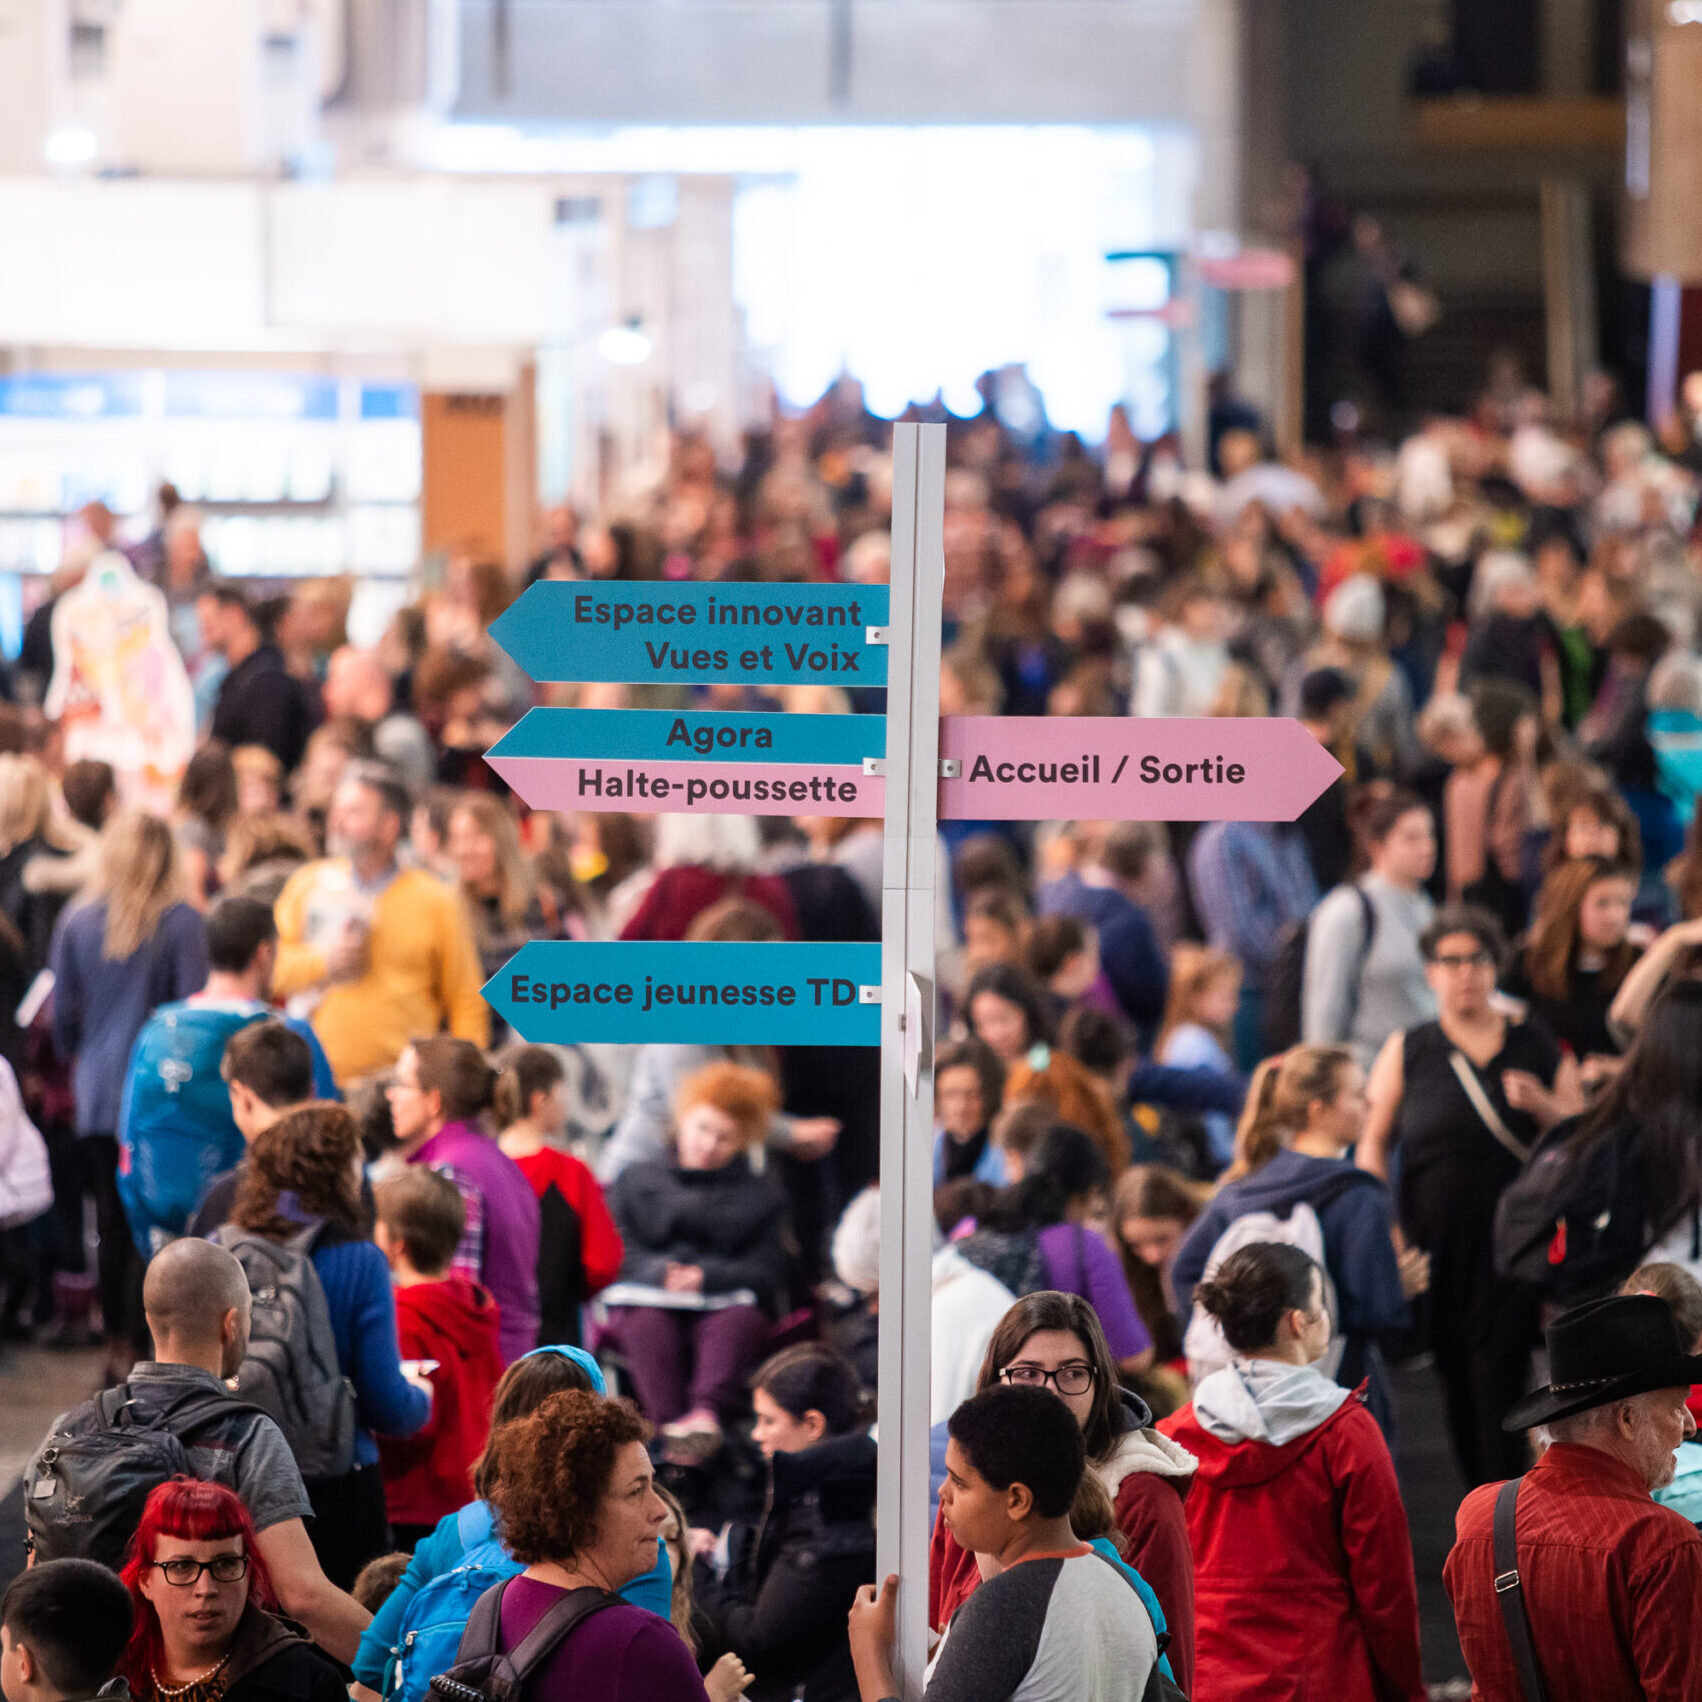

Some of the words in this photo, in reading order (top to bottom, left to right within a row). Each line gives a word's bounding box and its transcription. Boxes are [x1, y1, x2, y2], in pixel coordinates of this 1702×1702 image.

[574, 595, 697, 631] Espace
[708, 596, 861, 626] innovant
[645, 641, 729, 670] Vues
[739, 645, 773, 671] et
[784, 642, 860, 671] Voix
[666, 718, 773, 754] Agora
[578, 768, 857, 806] Halte-poussette
[968, 754, 1100, 784] Accueil
[1111, 755, 1129, 784] /
[1139, 754, 1246, 784] Sortie
[511, 975, 634, 1010] Espace
[641, 975, 796, 1012] jeunesse
[806, 978, 856, 1007] TD
